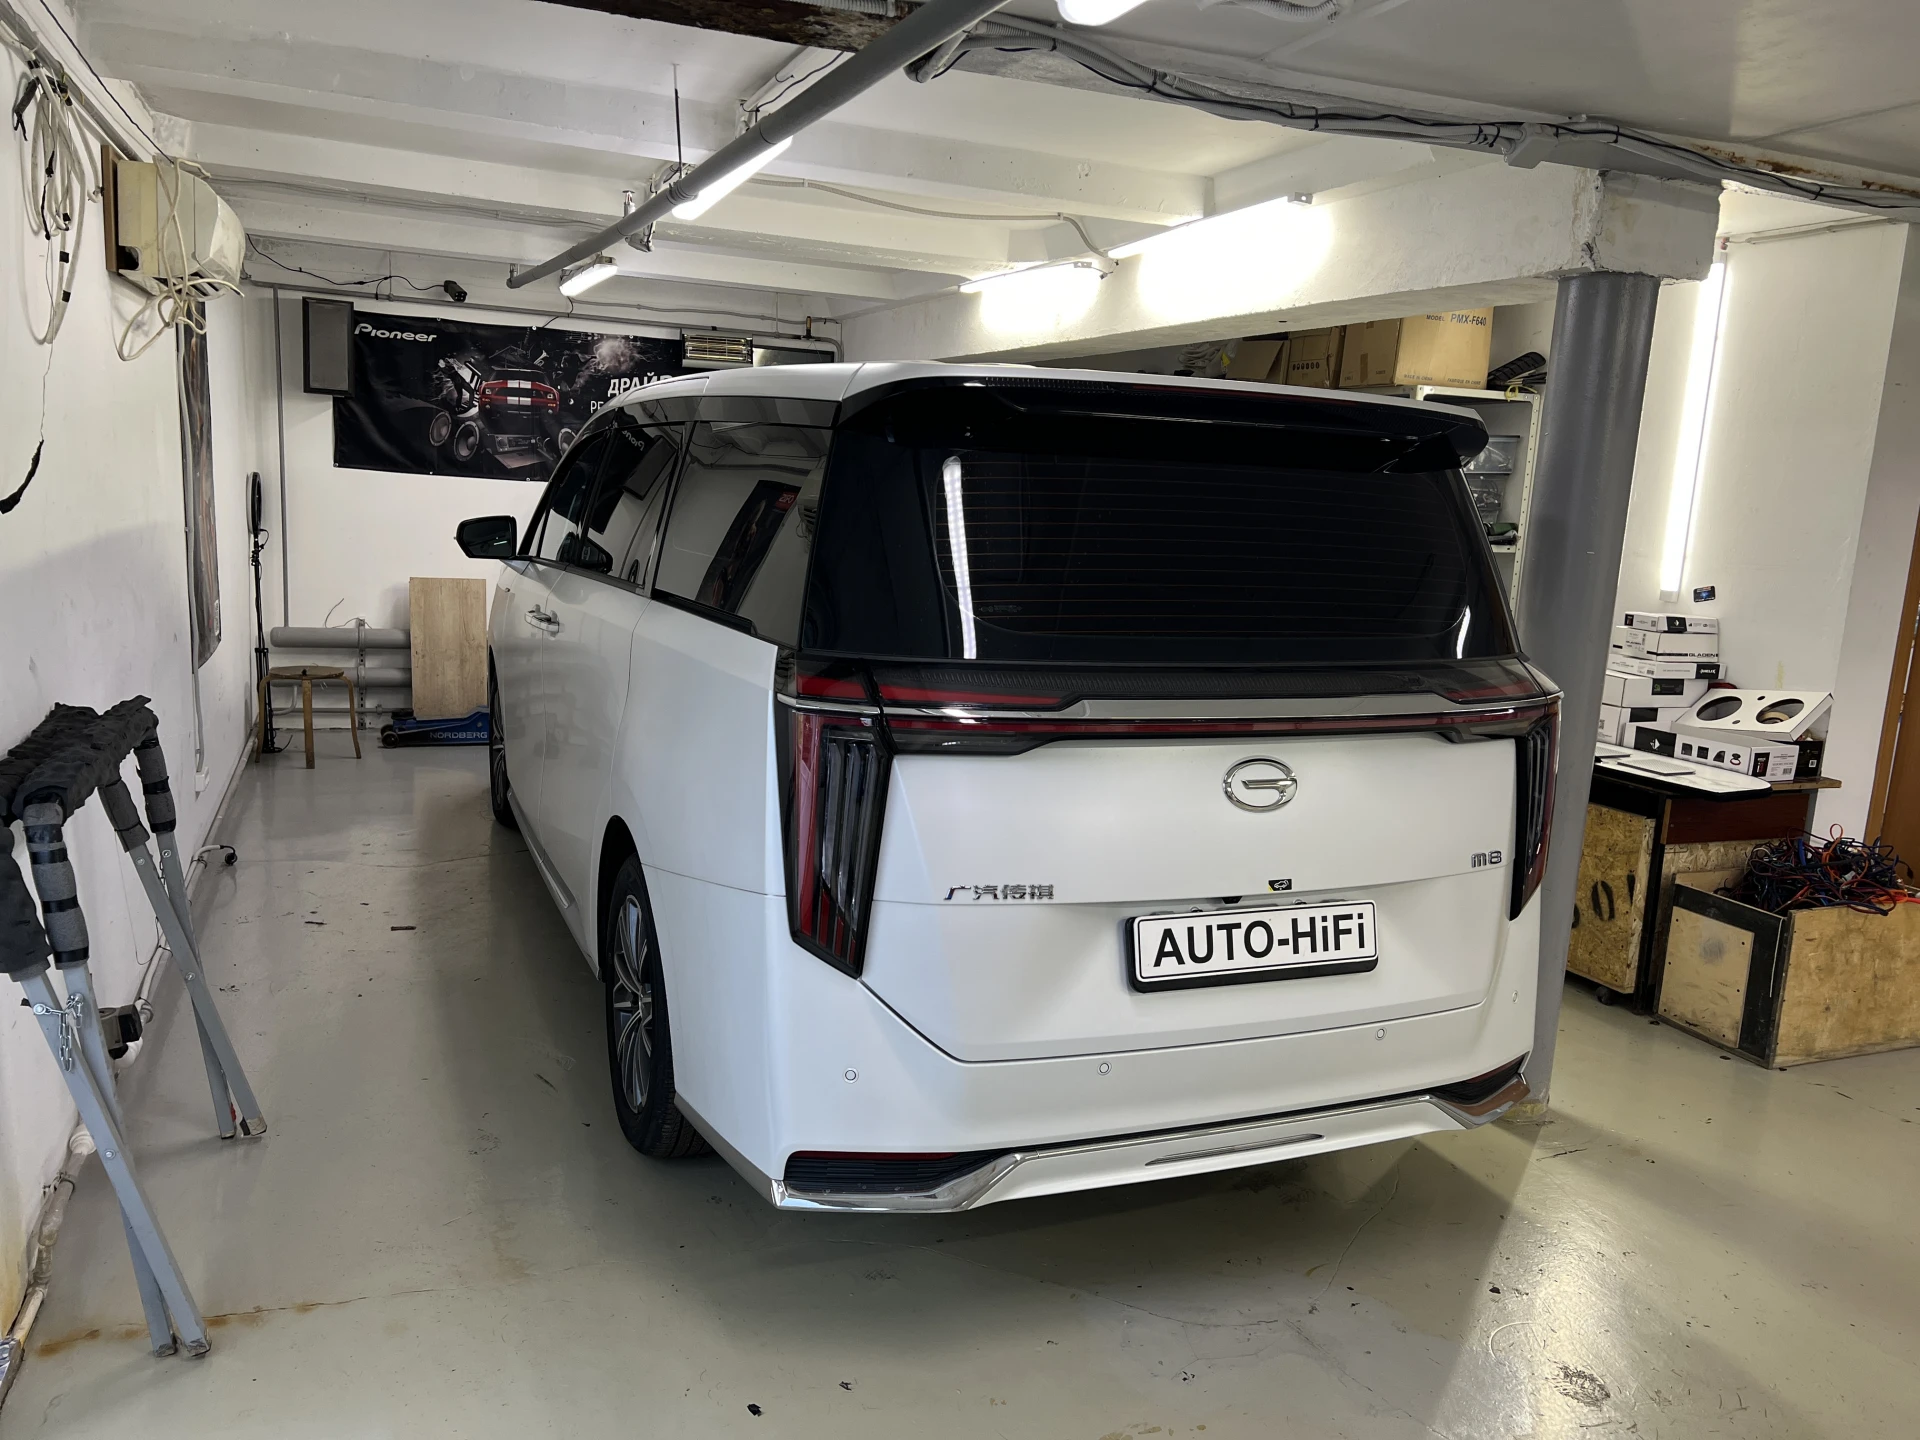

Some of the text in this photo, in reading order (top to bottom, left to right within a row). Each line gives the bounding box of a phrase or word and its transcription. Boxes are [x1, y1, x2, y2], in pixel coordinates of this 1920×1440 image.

[1425, 313, 1487, 326] MODEL PMX-F640
[354, 323, 437, 342] Pioneer
[429, 731, 488, 739] NORDBERG
[943, 884, 1055, 900] 广汽传祺
[1153, 911, 1366, 968] AUTO-HiFi
